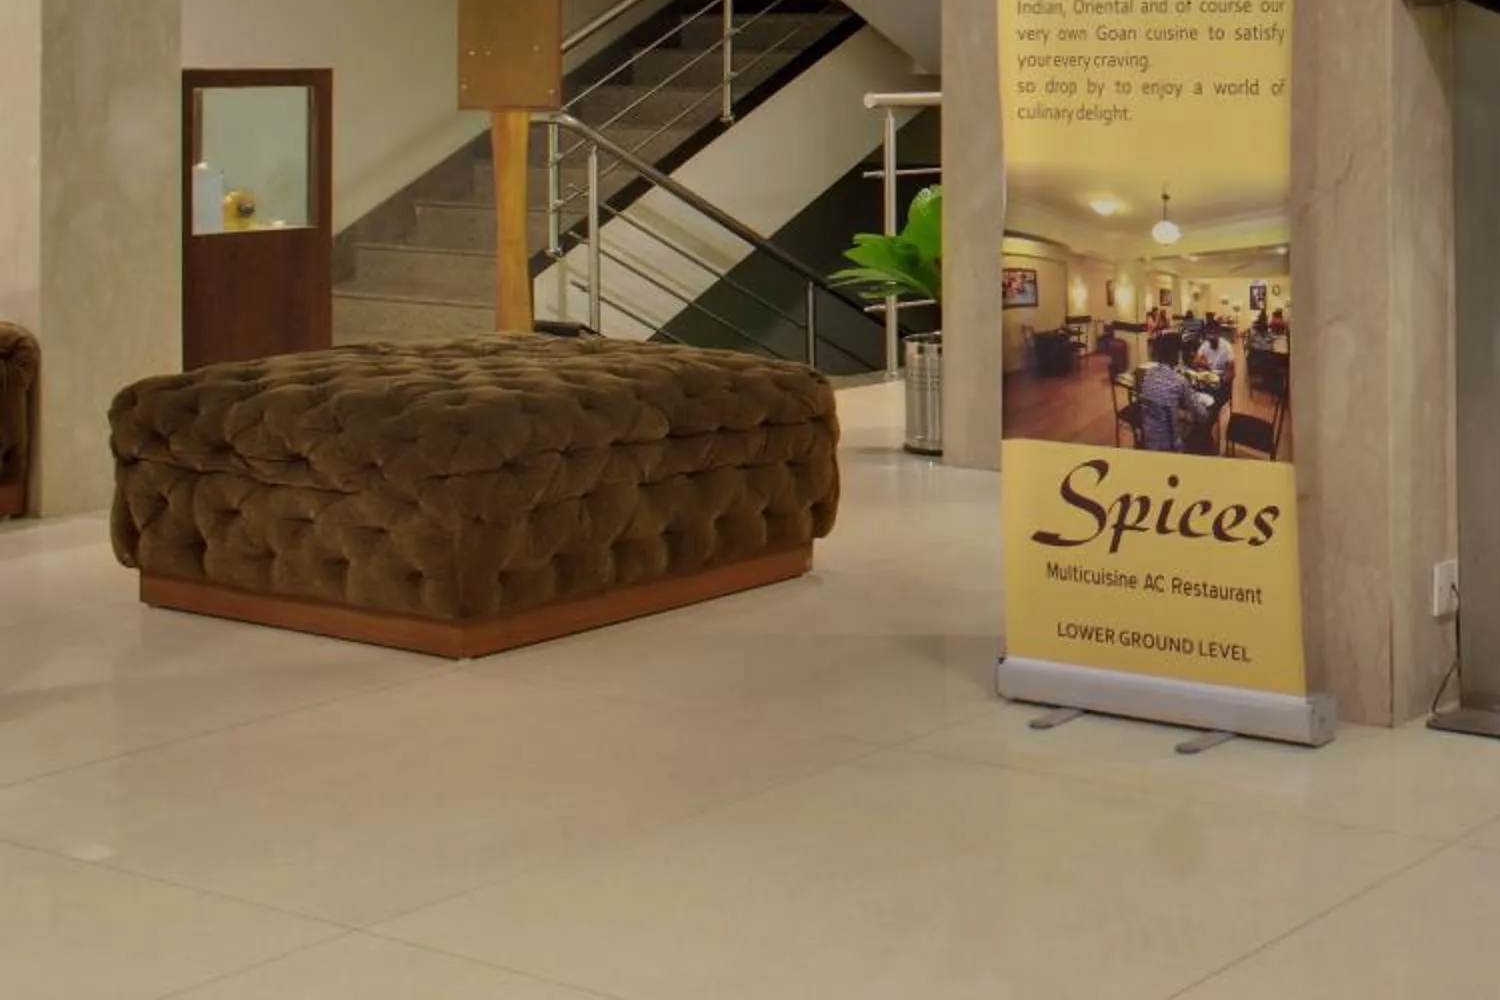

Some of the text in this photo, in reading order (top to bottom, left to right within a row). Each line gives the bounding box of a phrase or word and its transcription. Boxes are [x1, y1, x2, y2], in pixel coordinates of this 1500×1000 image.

[1017, 0, 1066, 18] Indian,
[1200, 0, 1252, 13] course
[1261, 0, 1284, 12] our
[1017, 24, 1284, 46] very own Goan cuisine to satisfy
[1018, 55, 1052, 70] your
[1053, 55, 1091, 70] every
[1017, 78, 1287, 100] so drop by to enjoy a world of
[1017, 106, 1075, 125] culinary
[1031, 459, 1281, 554] Spices
[1046, 561, 1263, 605] Multicuisine AC Restaurant
[1057, 622, 1252, 662] LOWER GROUND LEVEL
